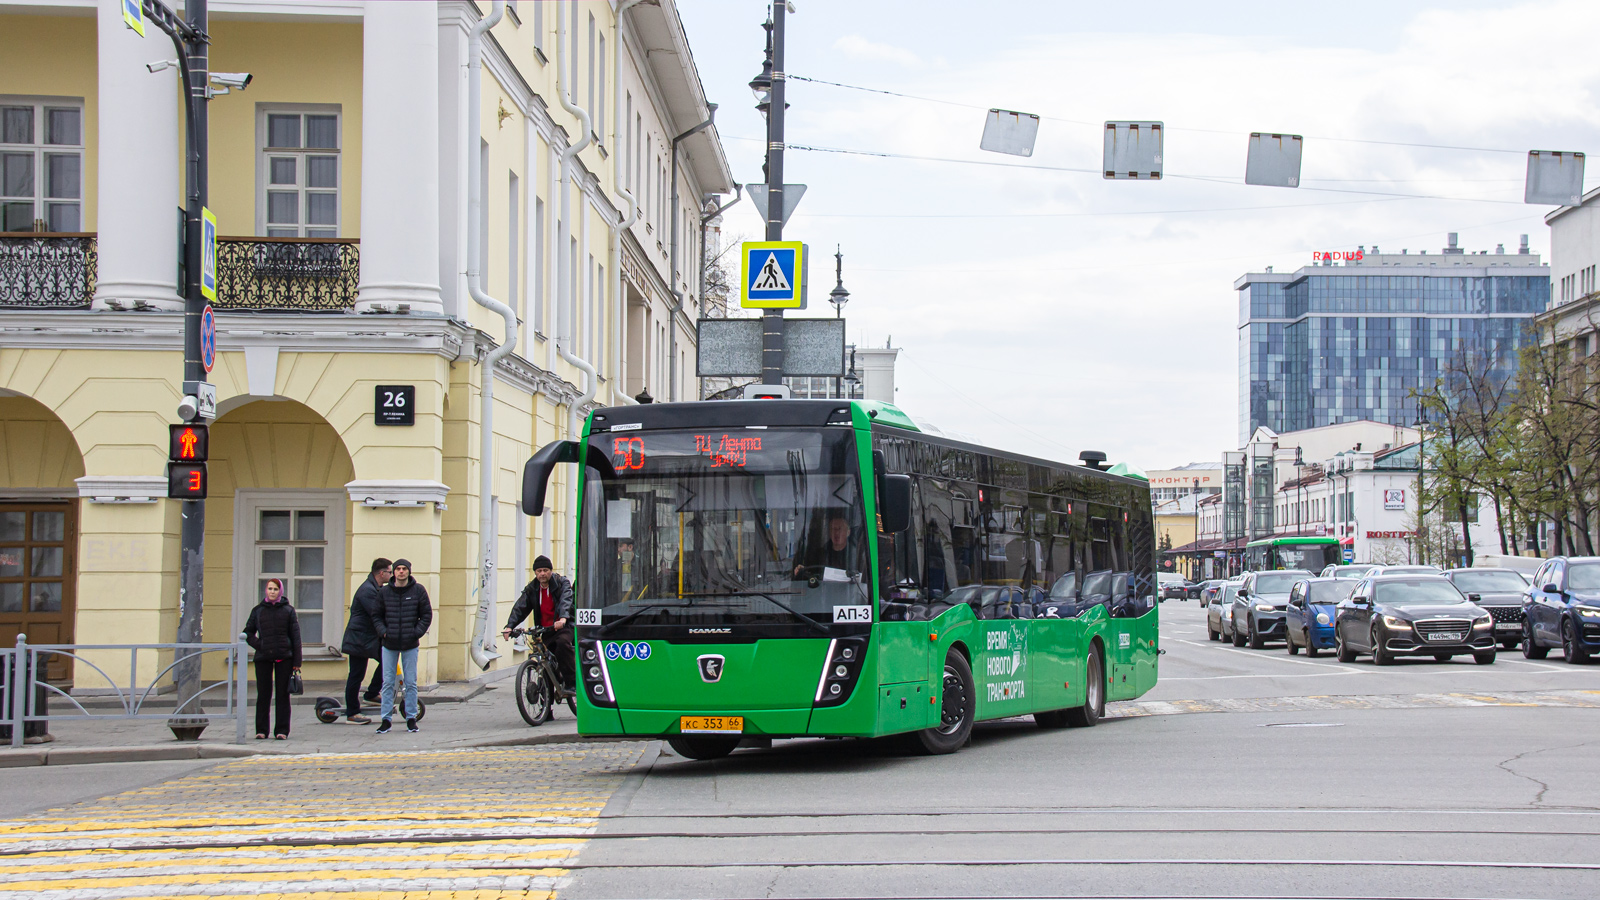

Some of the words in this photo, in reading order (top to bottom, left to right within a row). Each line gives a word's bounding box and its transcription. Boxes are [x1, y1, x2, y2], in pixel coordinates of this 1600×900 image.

[1313, 251, 1363, 260] RADIUS
[383, 391, 405, 407] 26
[694, 434, 711, 452] ТЦ
[718, 434, 762, 451] Лента
[614, 437, 645, 470] 50
[189, 471, 201, 491] 3
[578, 610, 597, 624] 936
[836, 608, 870, 620] АП-3
[987, 630, 1008, 651] ВРЕМЯ
[987, 656, 1011, 676] НОВОГО
[987, 680, 1025, 702] ТРАНСПОРТА
[685, 720, 698, 729] КС
[703, 718, 723, 729] 353
[728, 717, 739, 726] 66
